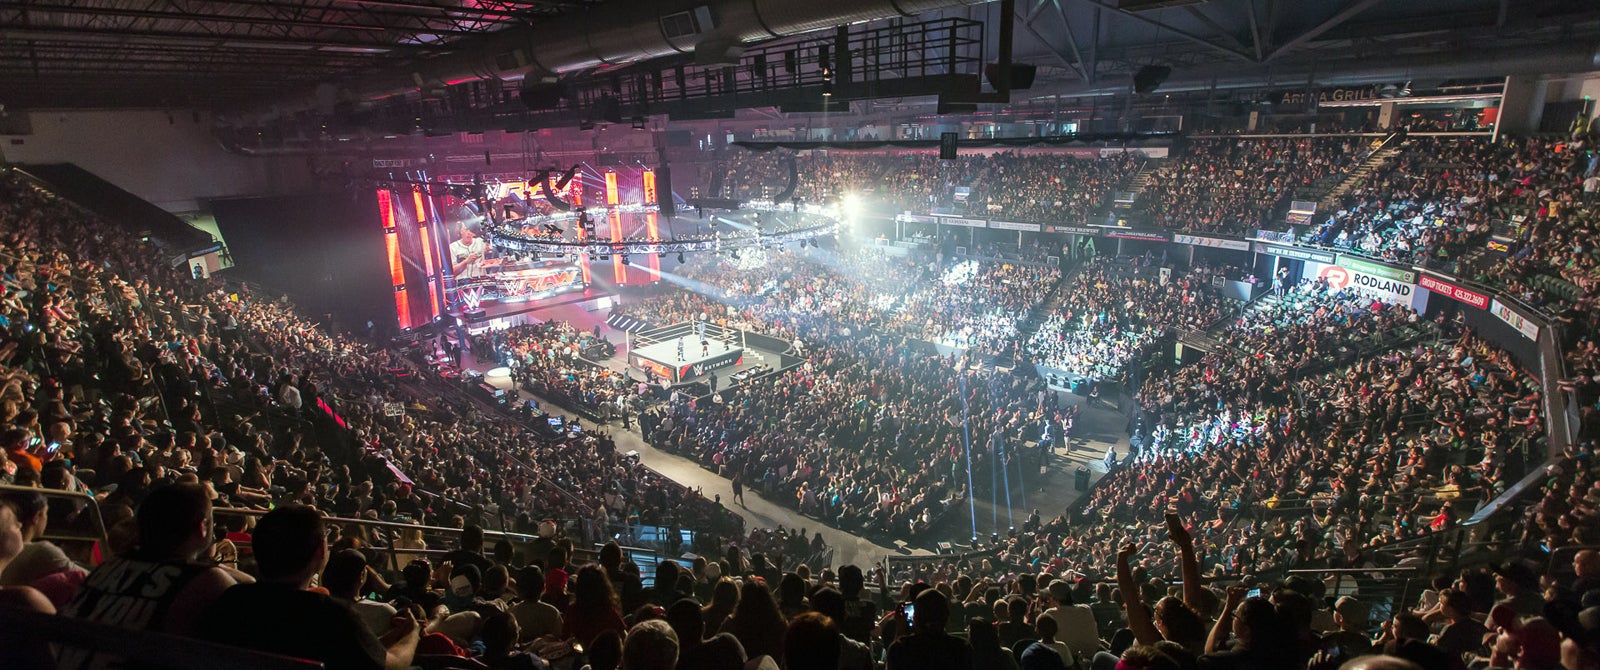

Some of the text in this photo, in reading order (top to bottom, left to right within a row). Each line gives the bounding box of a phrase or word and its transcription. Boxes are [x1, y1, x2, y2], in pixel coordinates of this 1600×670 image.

[1332, 89, 1377, 102] GRILL
[518, 271, 579, 292] RAW
[1353, 273, 1411, 297] RODLAND
[1436, 281, 1453, 295] TICKETS
[704, 358, 733, 371] NETWORK
